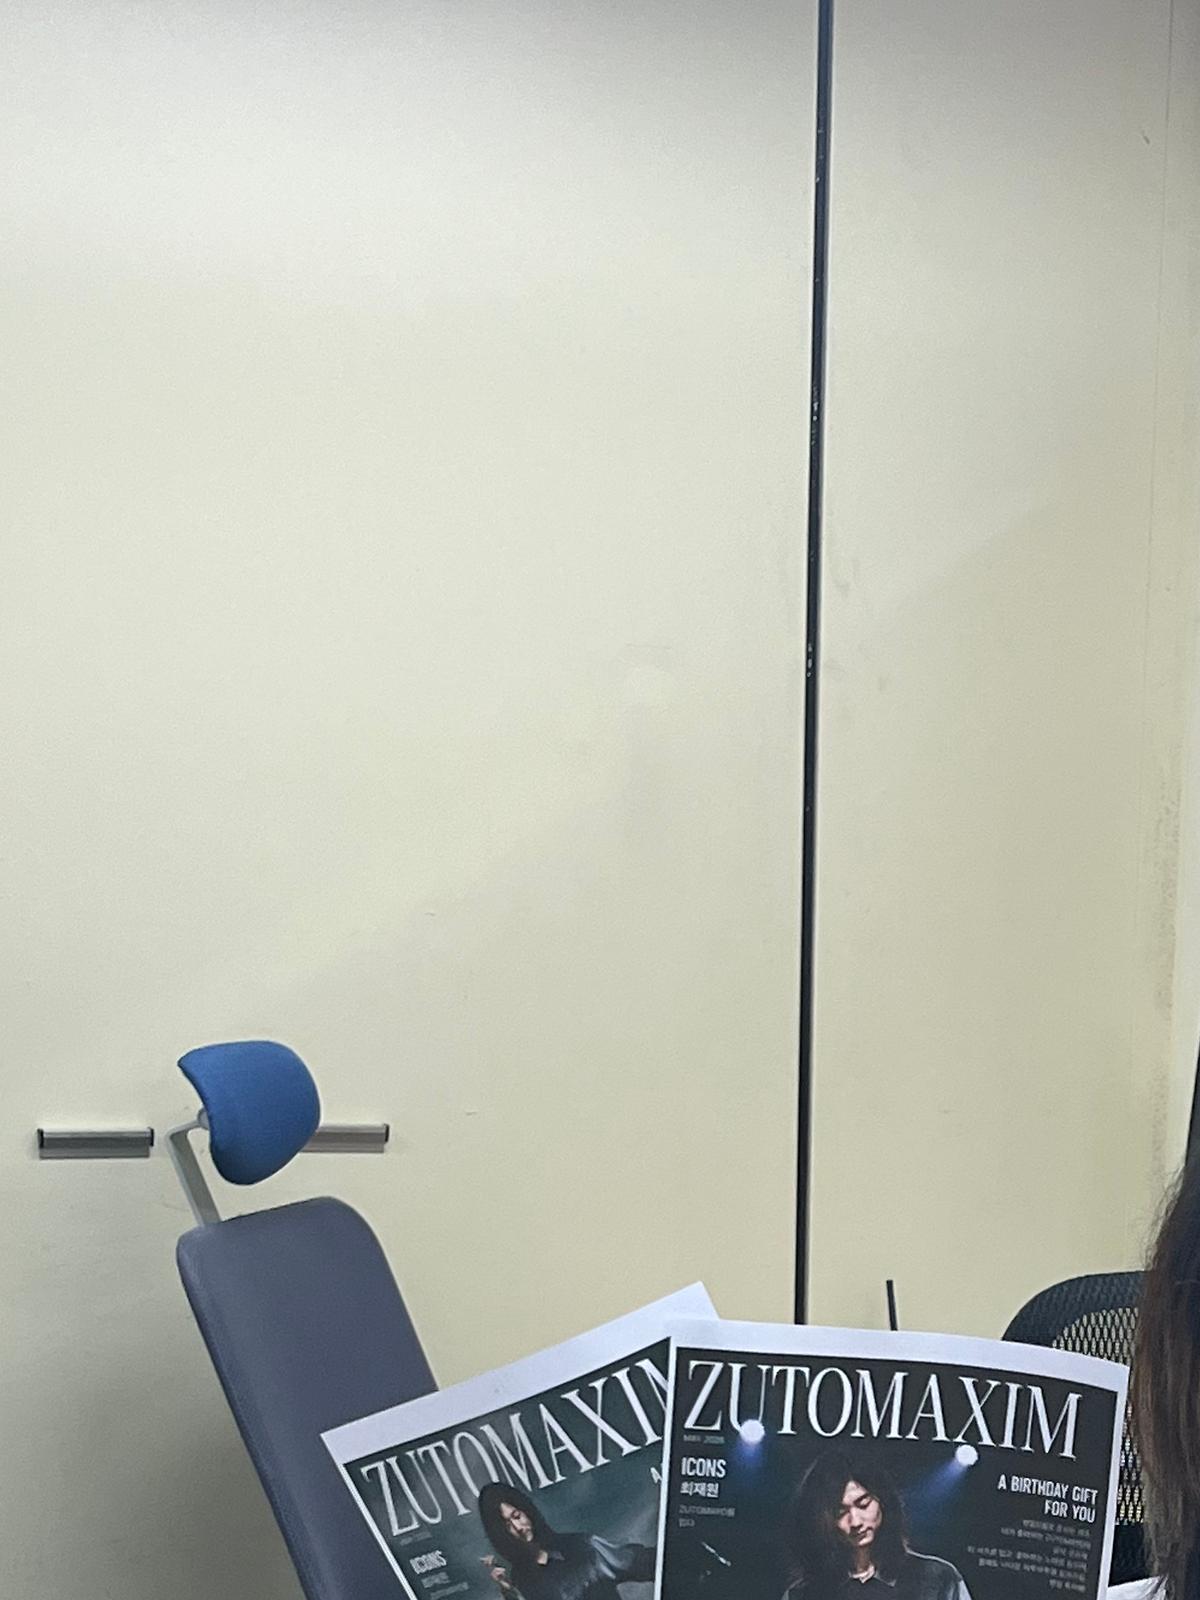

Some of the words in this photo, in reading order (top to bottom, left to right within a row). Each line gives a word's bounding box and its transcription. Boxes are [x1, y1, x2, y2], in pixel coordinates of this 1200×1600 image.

[683, 1360, 1082, 1460] ZUTOMAXIM
[681, 1456, 727, 1478] ICONS
[680, 1481, 719, 1498] 최재원
[997, 1473, 1007, 1490] A
[1011, 1475, 1069, 1499] BIRTHDAY
[1071, 1486, 1098, 1506] GIFT
[1044, 1500, 1068, 1518] FOR
[1072, 1504, 1096, 1523] YOU
